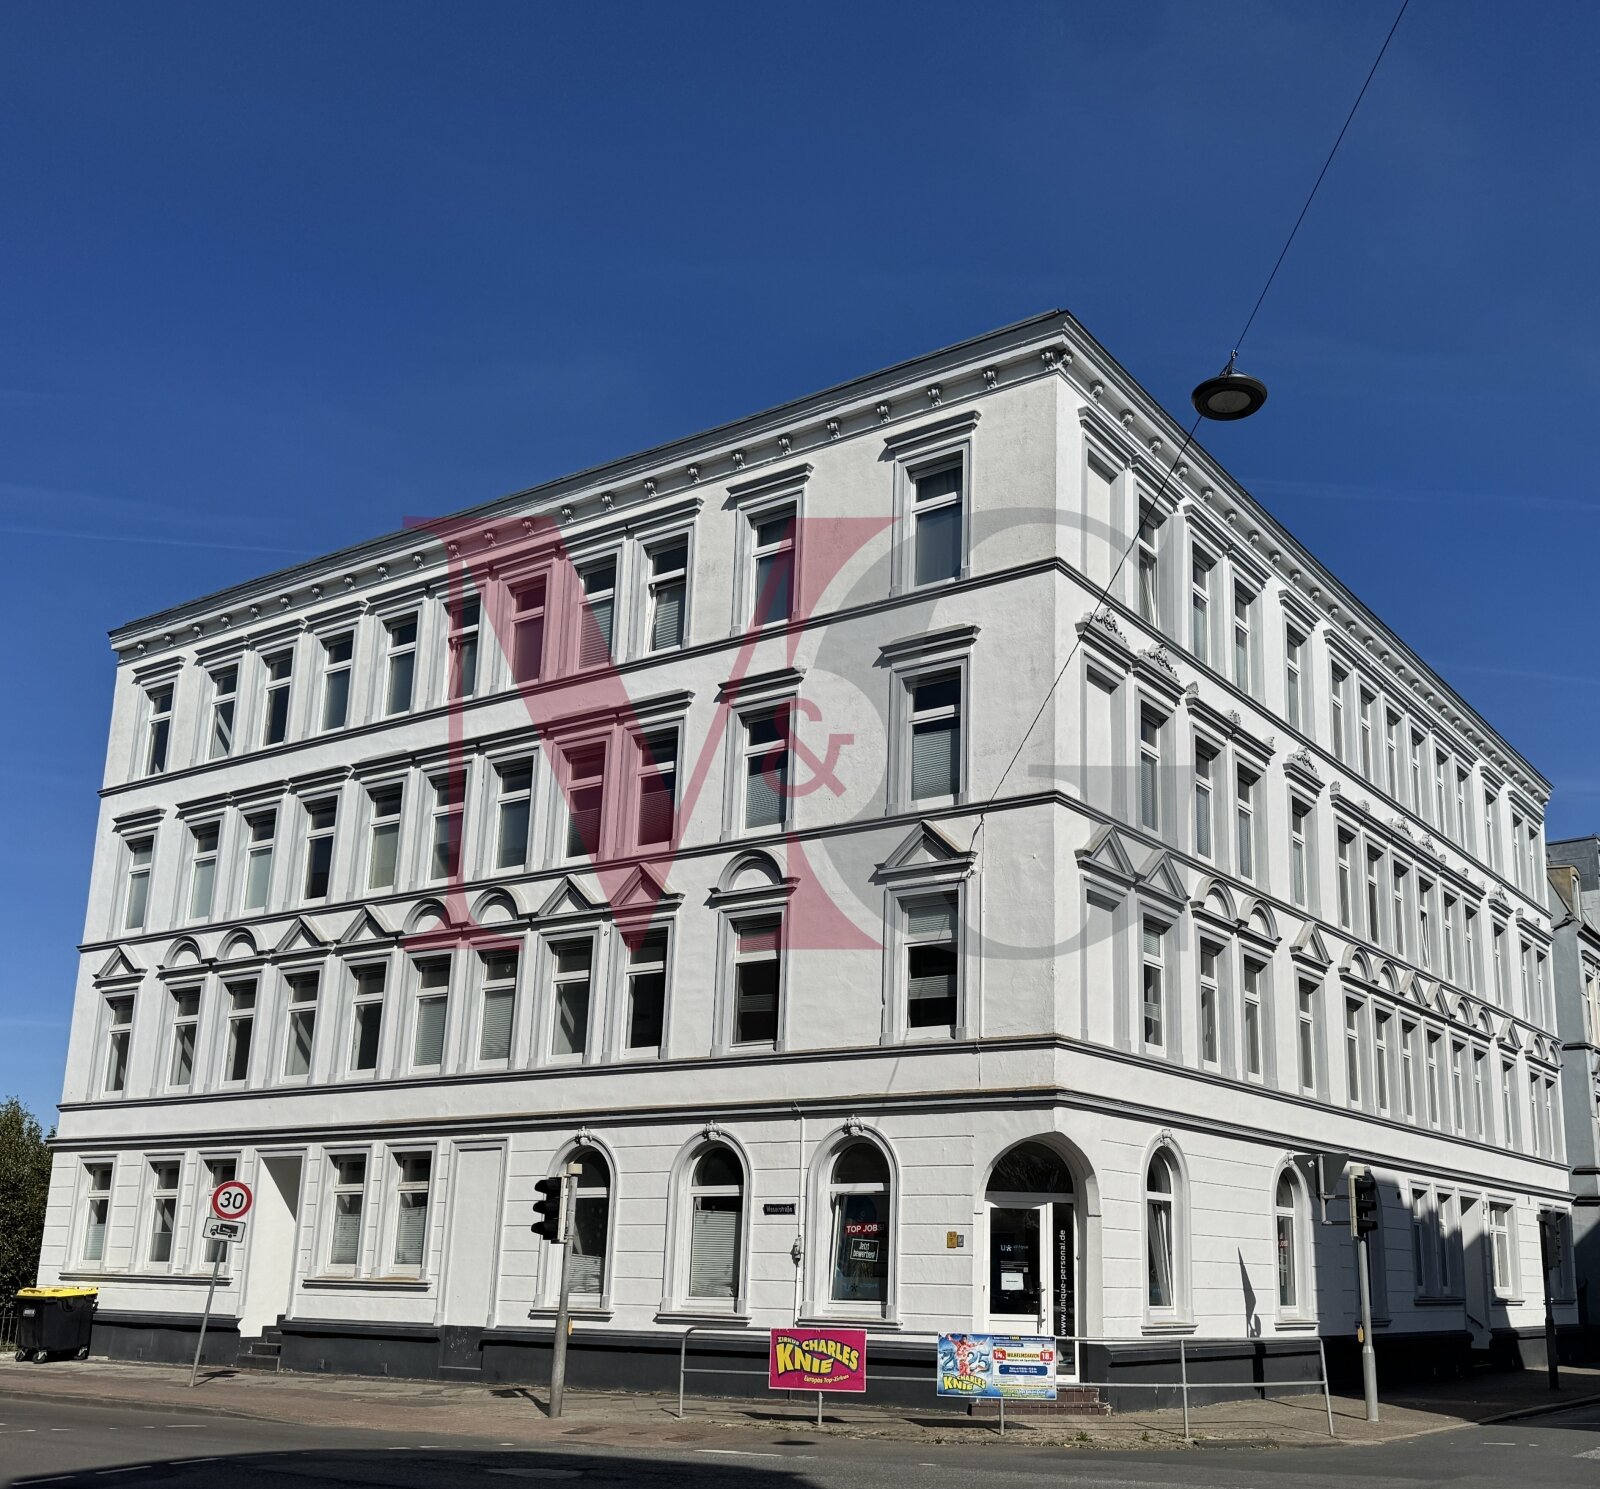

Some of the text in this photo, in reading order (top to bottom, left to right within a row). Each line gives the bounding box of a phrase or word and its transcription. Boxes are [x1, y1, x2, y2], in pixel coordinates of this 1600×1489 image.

[220, 1191, 244, 1209] 30
[846, 1225, 862, 1233] TOP
[859, 1242, 870, 1250] Jetzt
[852, 1249, 876, 1259] bewerben!
[1059, 1229, 1067, 1336] www.unique-personal.de
[776, 1343, 835, 1375] KNIE
[801, 1339, 860, 1372] CHARLES
[939, 1349, 991, 1372] 225
[994, 1351, 1005, 1359] 14.
[1042, 1352, 1052, 1360] 18.
[943, 1376, 973, 1390] KNIE
[957, 1375, 986, 1390] CHARLES
